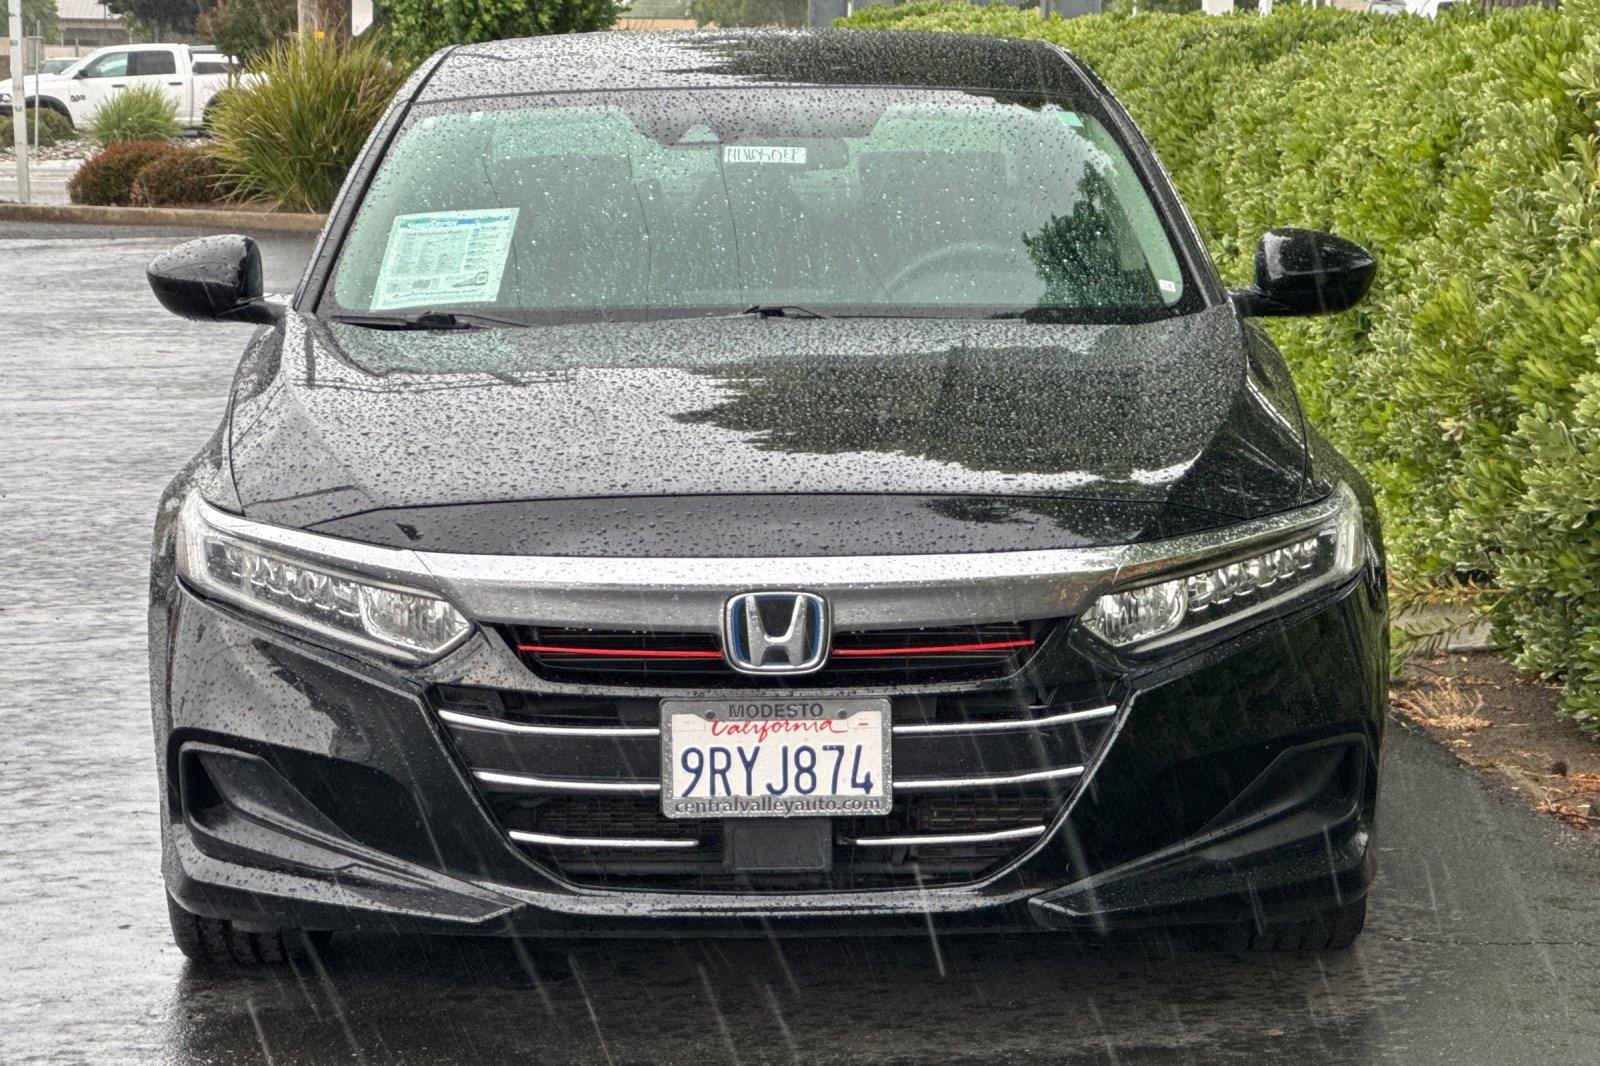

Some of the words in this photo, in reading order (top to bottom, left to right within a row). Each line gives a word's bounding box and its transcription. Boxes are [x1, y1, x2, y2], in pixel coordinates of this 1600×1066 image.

[728, 702, 824, 719] MODESTO
[711, 720, 848, 743] California
[680, 744, 874, 797] 9RYJ874
[675, 797, 881, 815] centralvalleyauto.com
